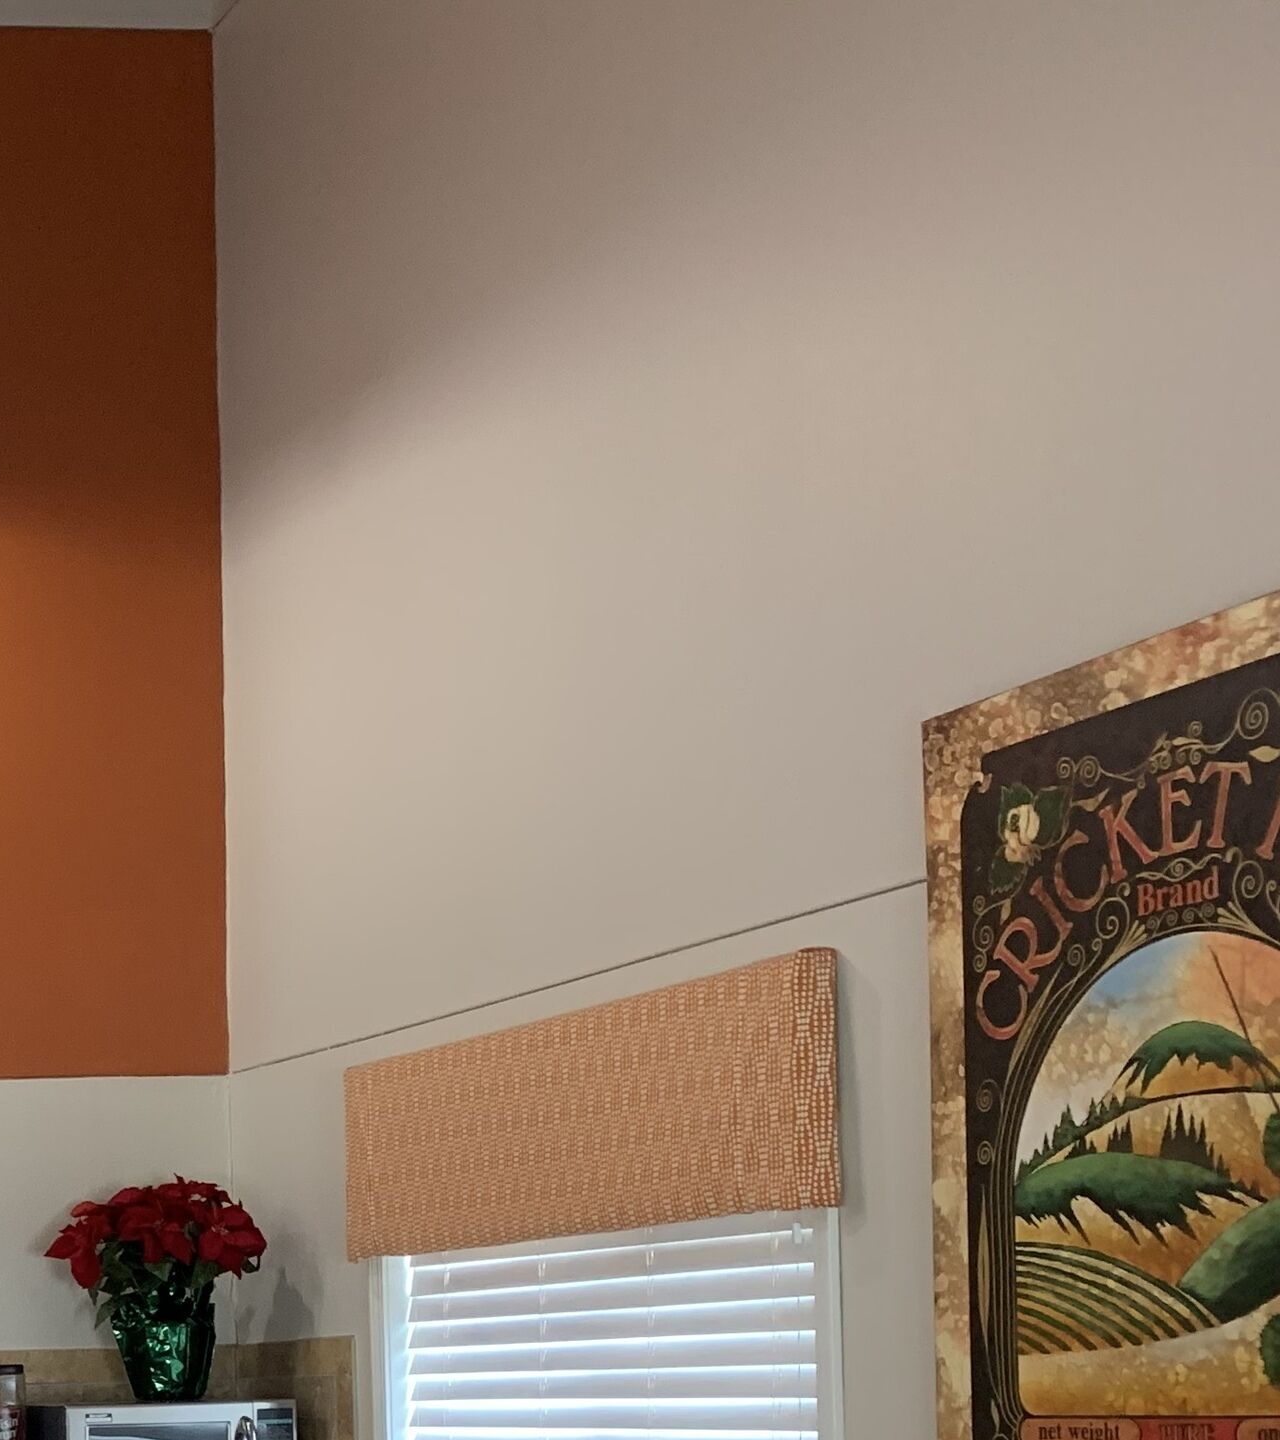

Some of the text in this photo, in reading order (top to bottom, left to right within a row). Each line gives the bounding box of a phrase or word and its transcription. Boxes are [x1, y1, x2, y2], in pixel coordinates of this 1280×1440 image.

[976, 761, 1252, 1040] CRICKET
[1137, 865, 1219, 917] Brand
[1038, 1422, 1062, 1440] net
